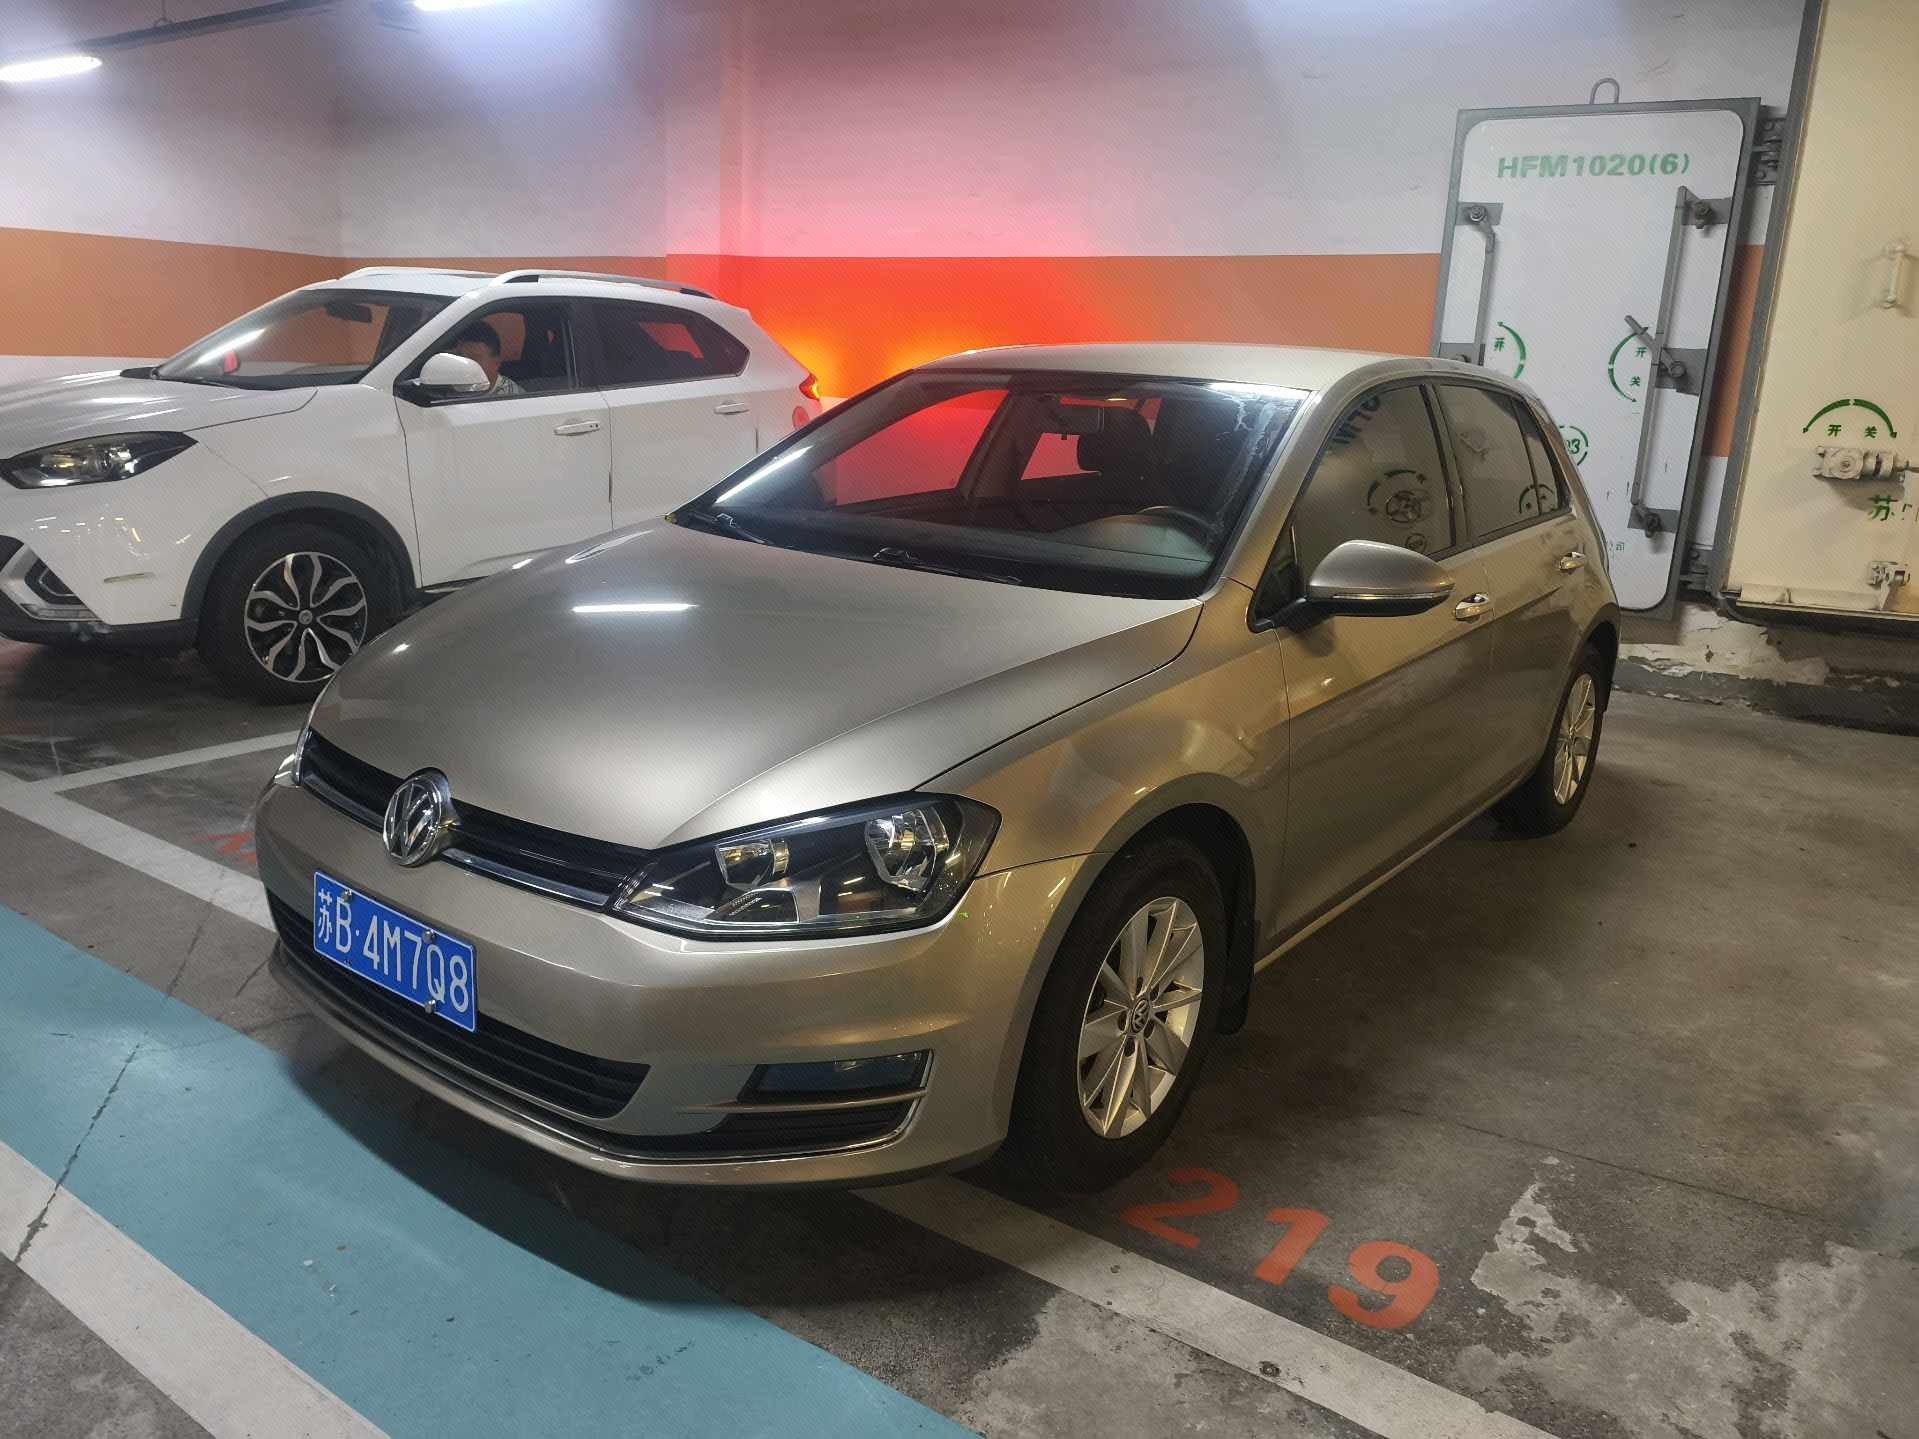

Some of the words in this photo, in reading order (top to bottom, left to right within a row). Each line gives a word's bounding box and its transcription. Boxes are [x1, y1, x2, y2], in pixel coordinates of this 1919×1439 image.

[1497, 152, 1690, 178] HFM1020(6)
[1635, 346, 1647, 358] 开
[1630, 376, 1641, 387] 关
[1827, 424, 1842, 437] 开
[1865, 426, 1878, 439] 关
[1120, 1167, 1439, 1330] 219
